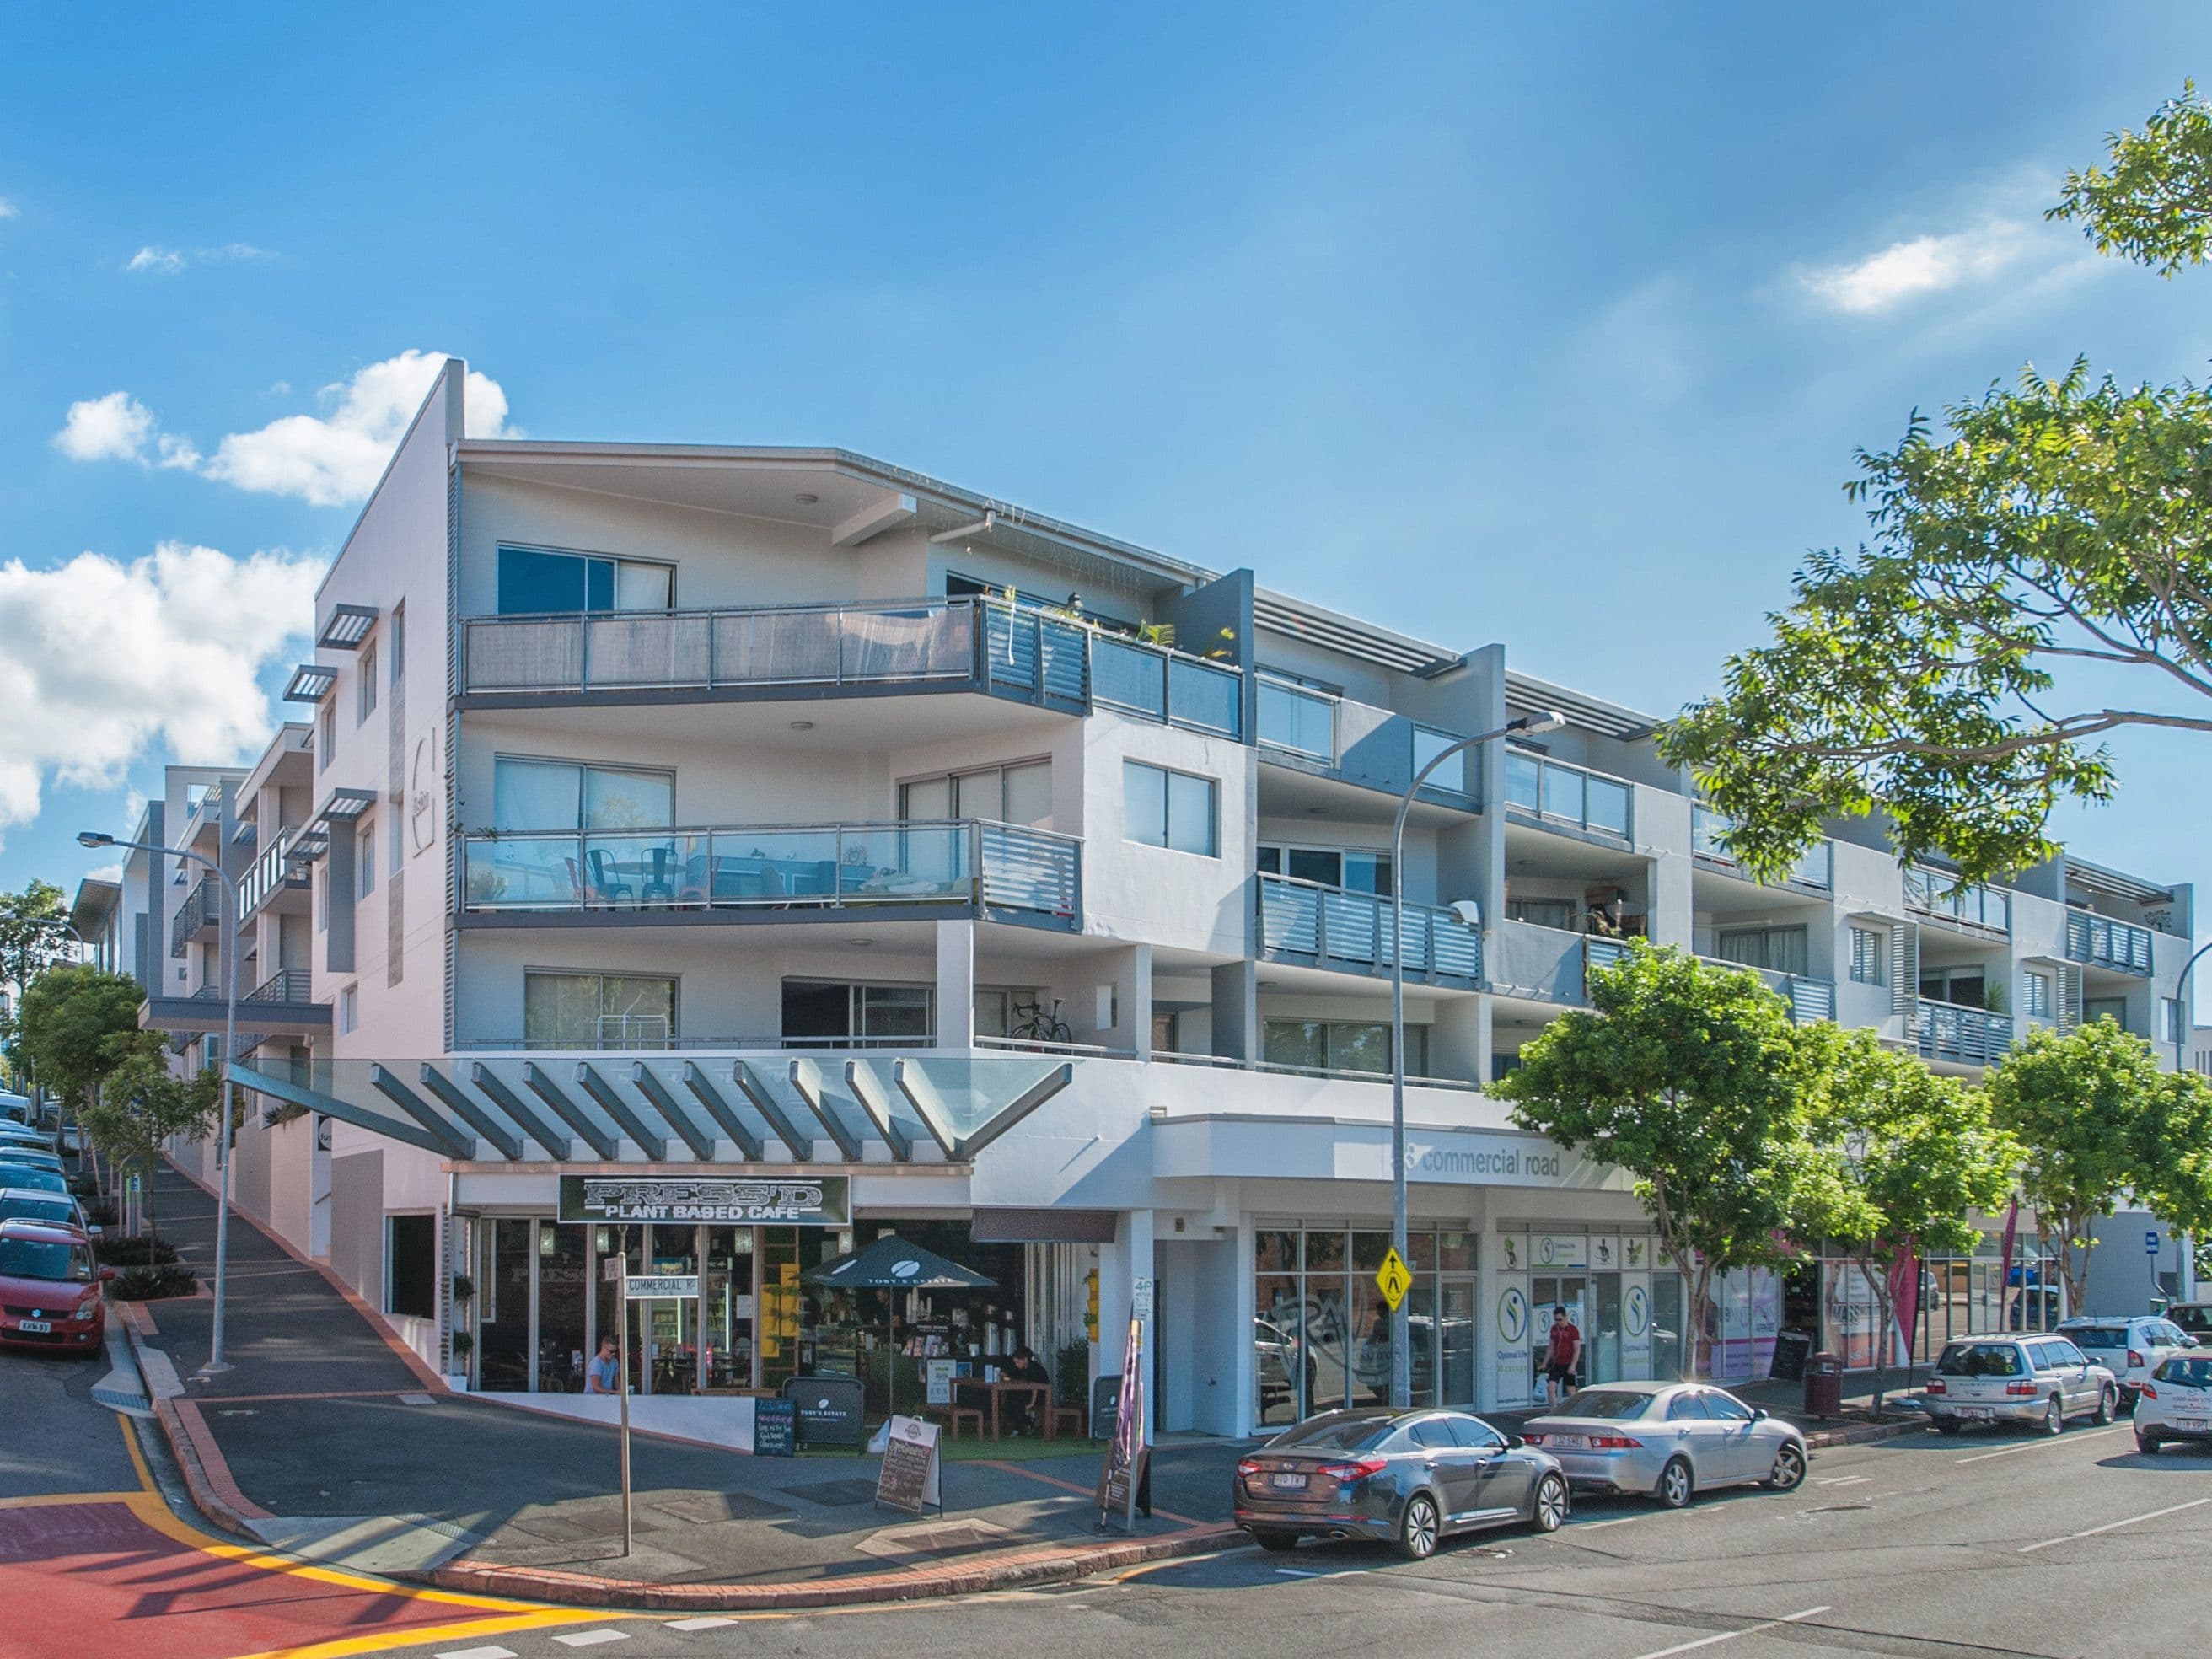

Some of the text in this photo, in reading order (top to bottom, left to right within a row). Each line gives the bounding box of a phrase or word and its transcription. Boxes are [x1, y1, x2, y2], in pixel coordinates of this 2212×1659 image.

[1423, 1148, 1520, 1174] commercial
[1525, 1152, 1560, 1177] road
[584, 1184, 823, 1206] PRESS'D
[605, 1205, 800, 1220] PLANT BASED CAFE
[629, 1279, 681, 1291] COMMERCIAL
[1136, 1280, 1152, 1291] 4P
